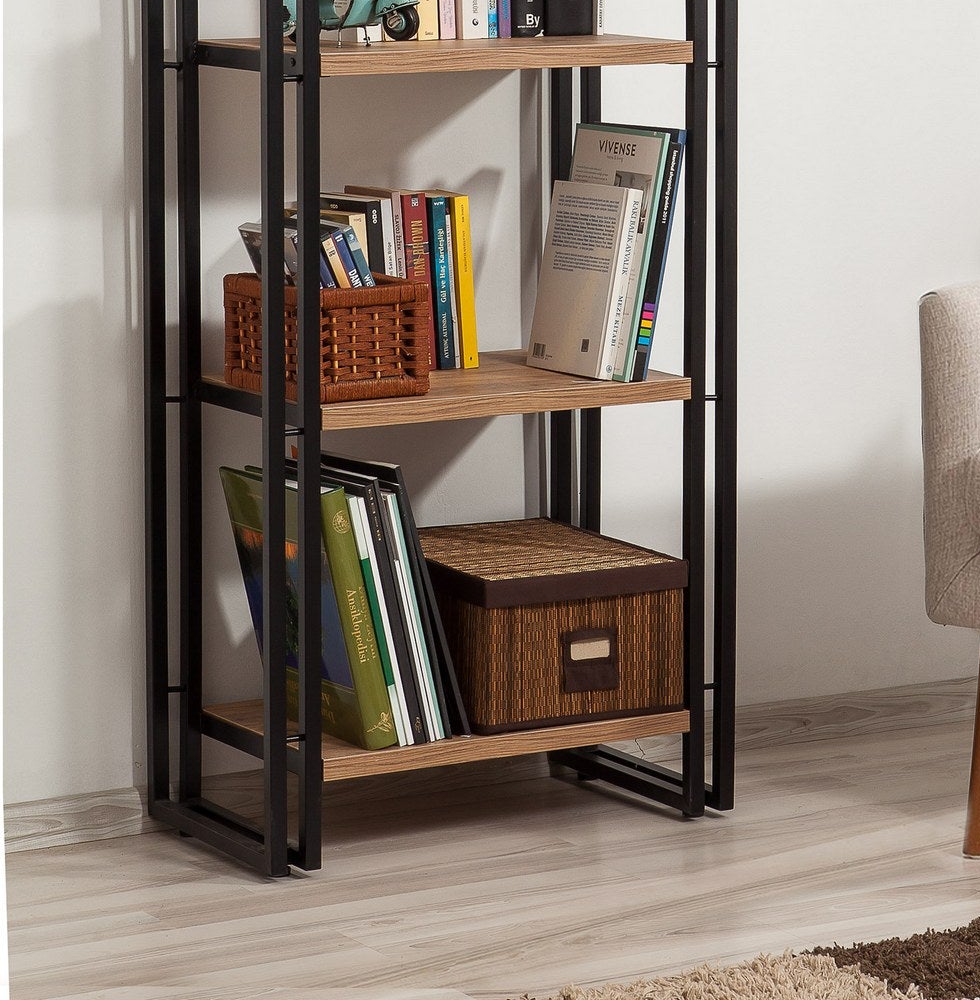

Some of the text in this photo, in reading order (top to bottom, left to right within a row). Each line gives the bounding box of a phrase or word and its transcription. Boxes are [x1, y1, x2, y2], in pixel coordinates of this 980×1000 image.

[526, 13, 541, 28] By
[410, 219, 426, 277] DAN BROWN
[437, 228, 445, 264] Kardeşliği
[621, 200, 640, 275] RAKI BALIK AYVALIK
[439, 265, 447, 279] Haç
[440, 280, 446, 289] ve
[615, 295, 624, 317] MEZE
[442, 338, 450, 359] AYTUNÇ
[346, 588, 370, 664] Ansiklopedisi
